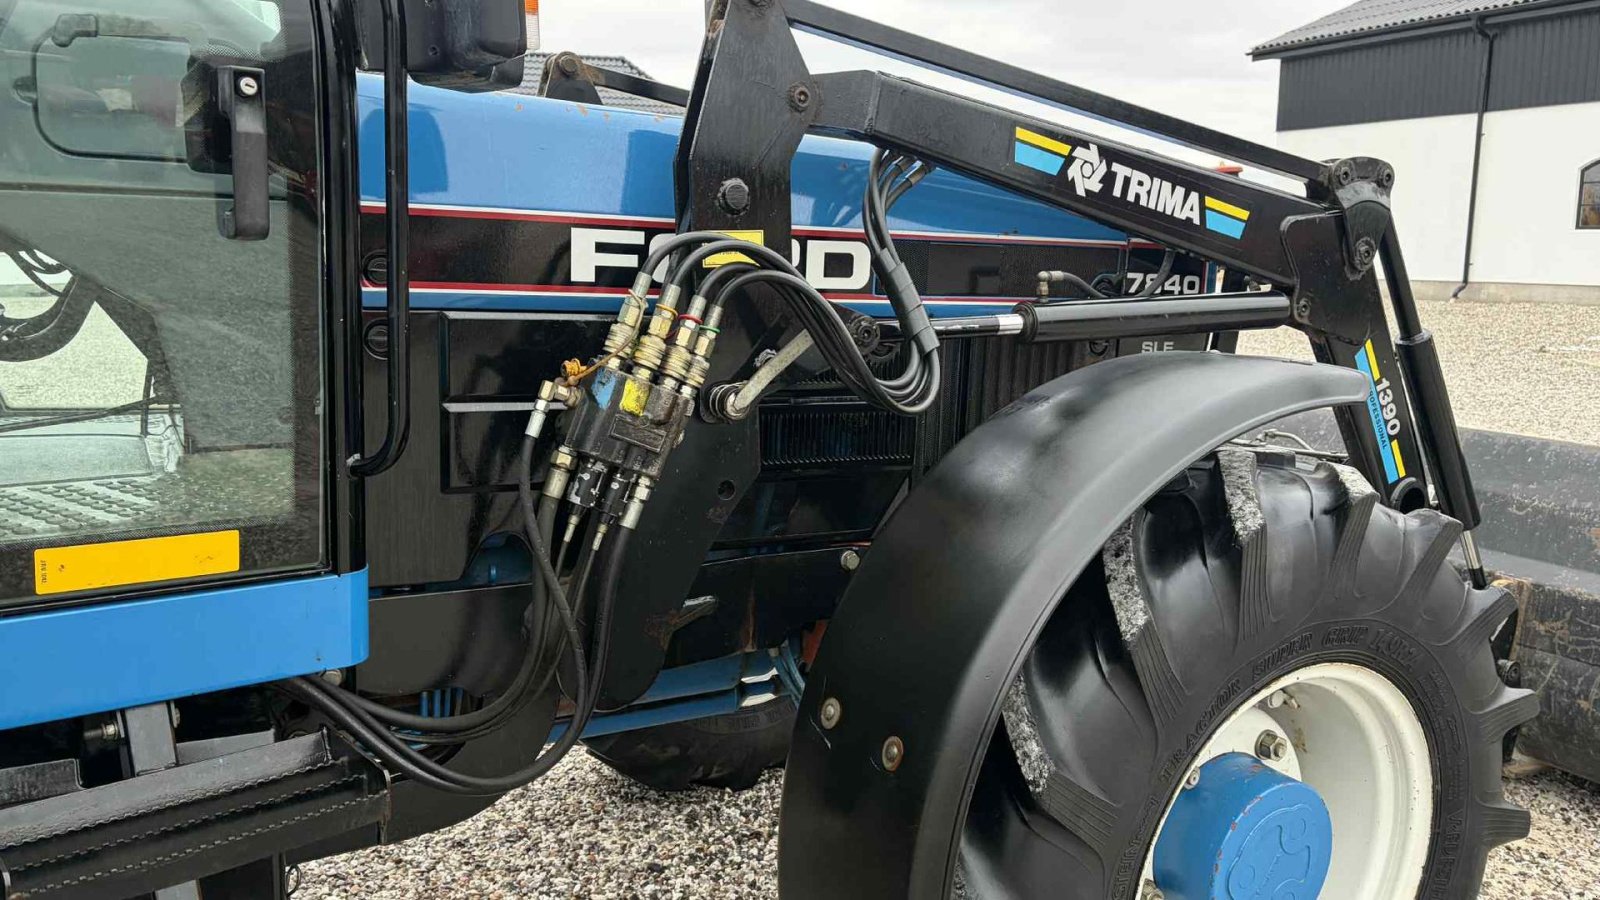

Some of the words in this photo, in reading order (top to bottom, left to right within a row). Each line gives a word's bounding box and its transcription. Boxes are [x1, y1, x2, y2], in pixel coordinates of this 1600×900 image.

[1111, 162, 1200, 225] TRIMA
[1369, 390, 1388, 450] ROFESSIONAL
[1376, 377, 1401, 436] 1390
[1252, 632, 1313, 682] SUPER
